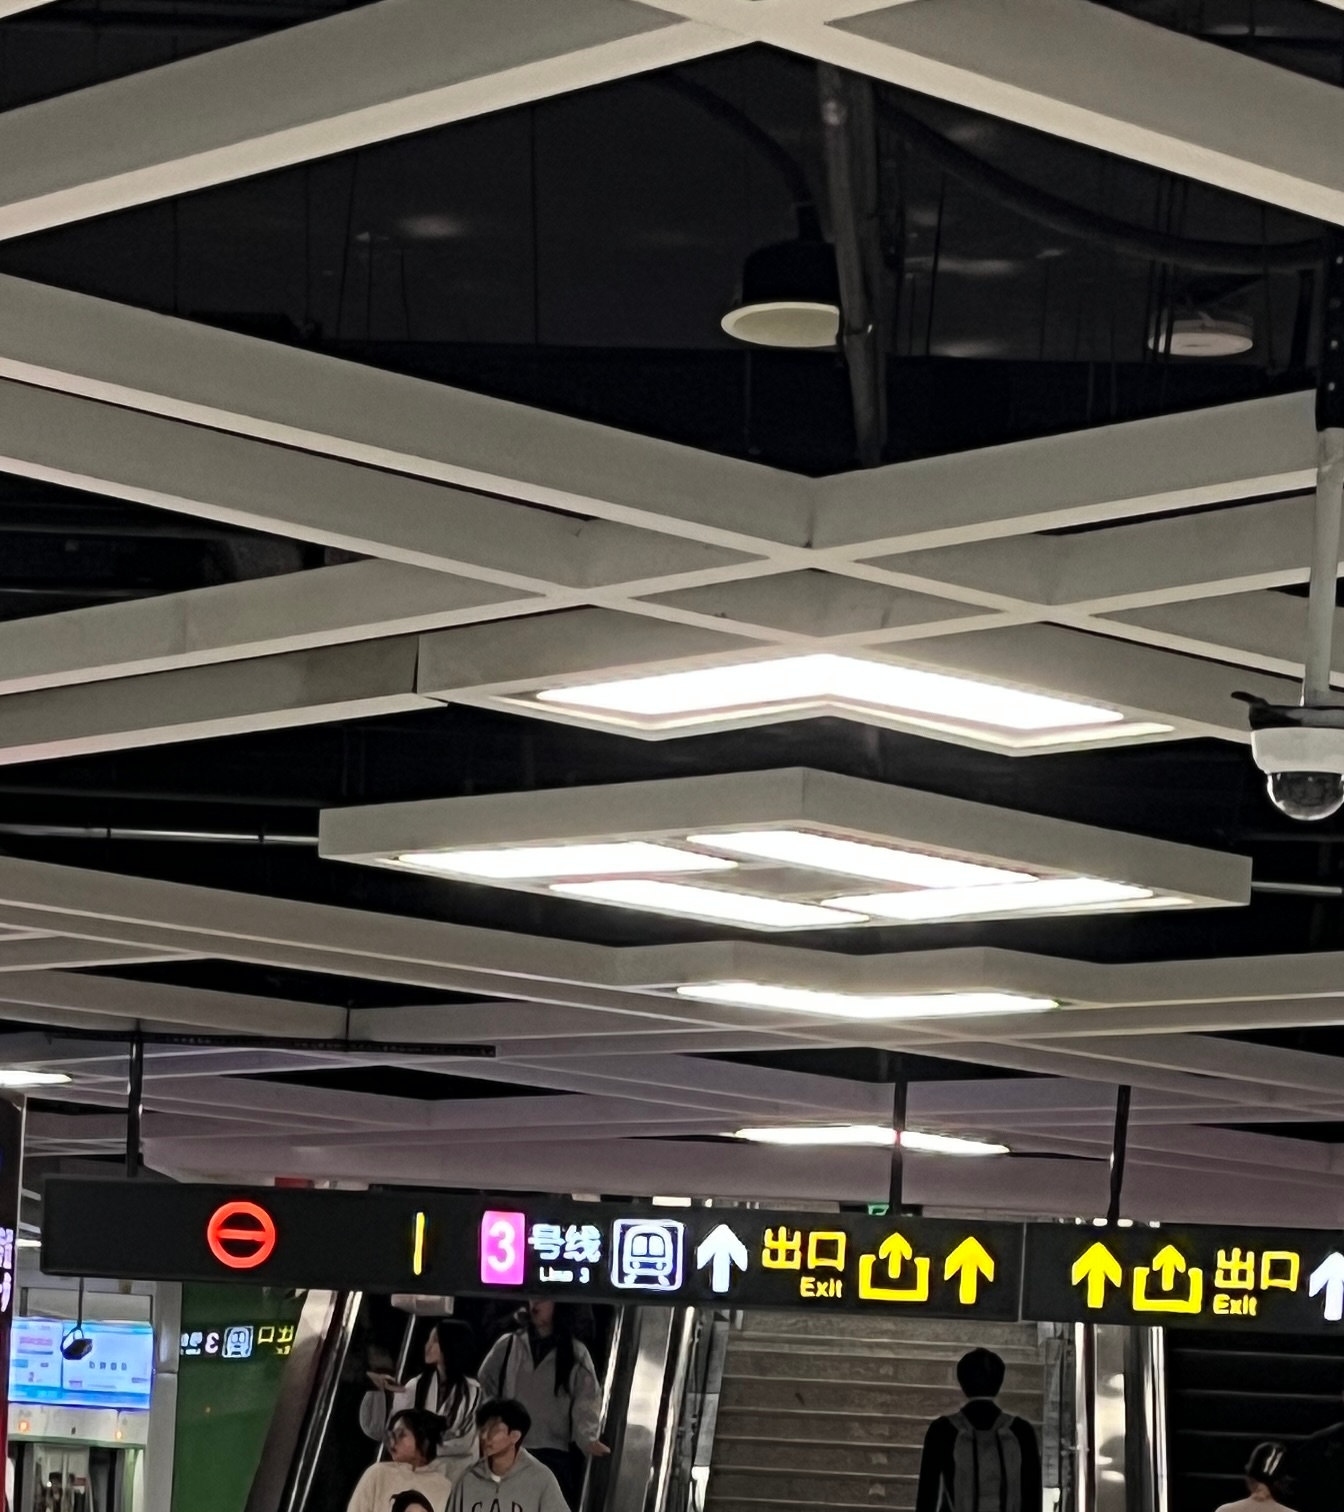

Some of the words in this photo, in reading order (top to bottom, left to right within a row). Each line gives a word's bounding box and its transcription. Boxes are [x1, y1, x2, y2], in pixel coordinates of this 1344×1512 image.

[762, 1226, 846, 1272] 出口
[1215, 1247, 1300, 1292] 出口
[800, 1276, 843, 1298] Exit
[1213, 1294, 1257, 1316] Exit
